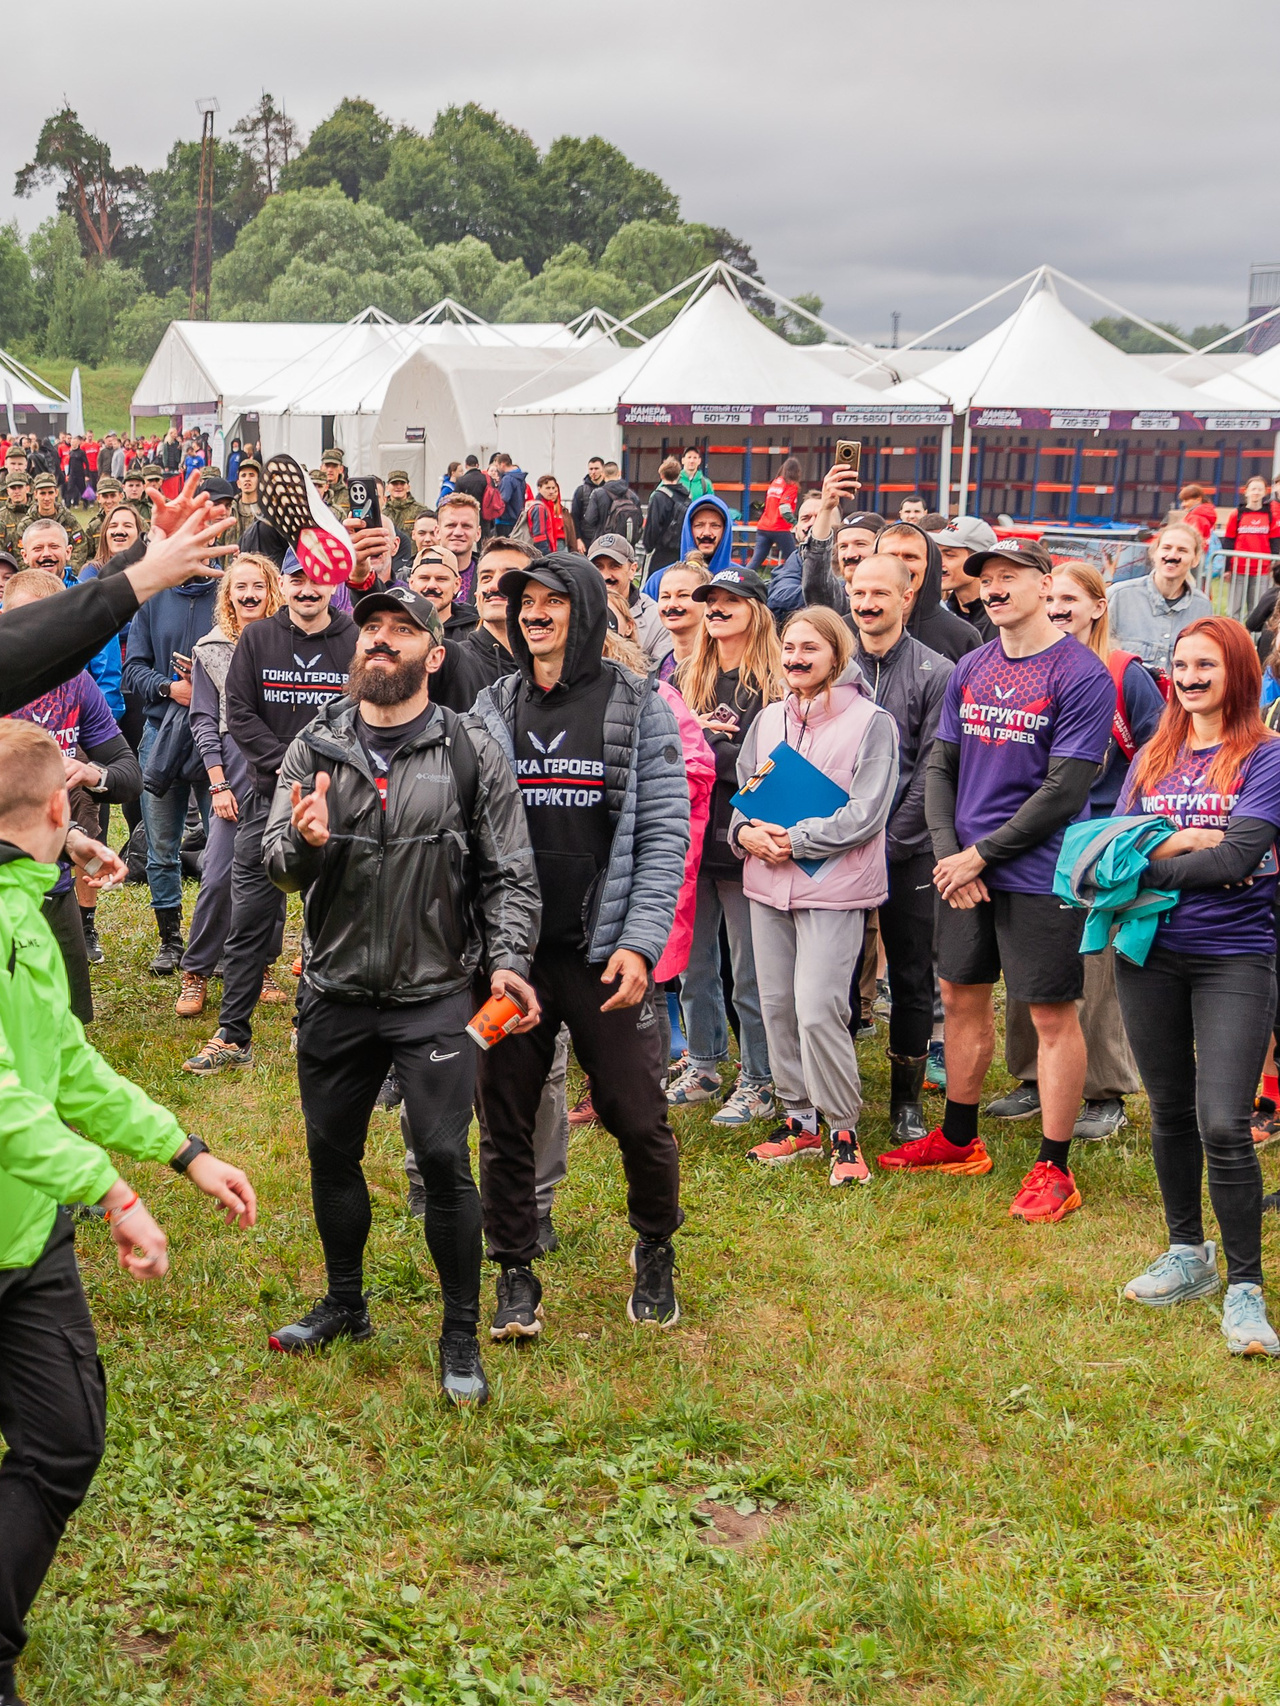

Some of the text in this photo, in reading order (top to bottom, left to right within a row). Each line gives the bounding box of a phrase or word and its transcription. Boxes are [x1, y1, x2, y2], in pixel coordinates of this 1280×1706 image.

[631, 406, 666, 415] КАМЕРА
[731, 405, 754, 413] СТАРТ
[625, 414, 672, 423] ХРАНЕНИЯ
[703, 413, 741, 423] 601-719
[778, 415, 809, 423] 111-125
[262, 669, 350, 684] ГОНКА ГЕРОЕВ
[993, 727, 1036, 745] ГЕРОЕВ
[543, 758, 604, 777] ГЕРОЕВ
